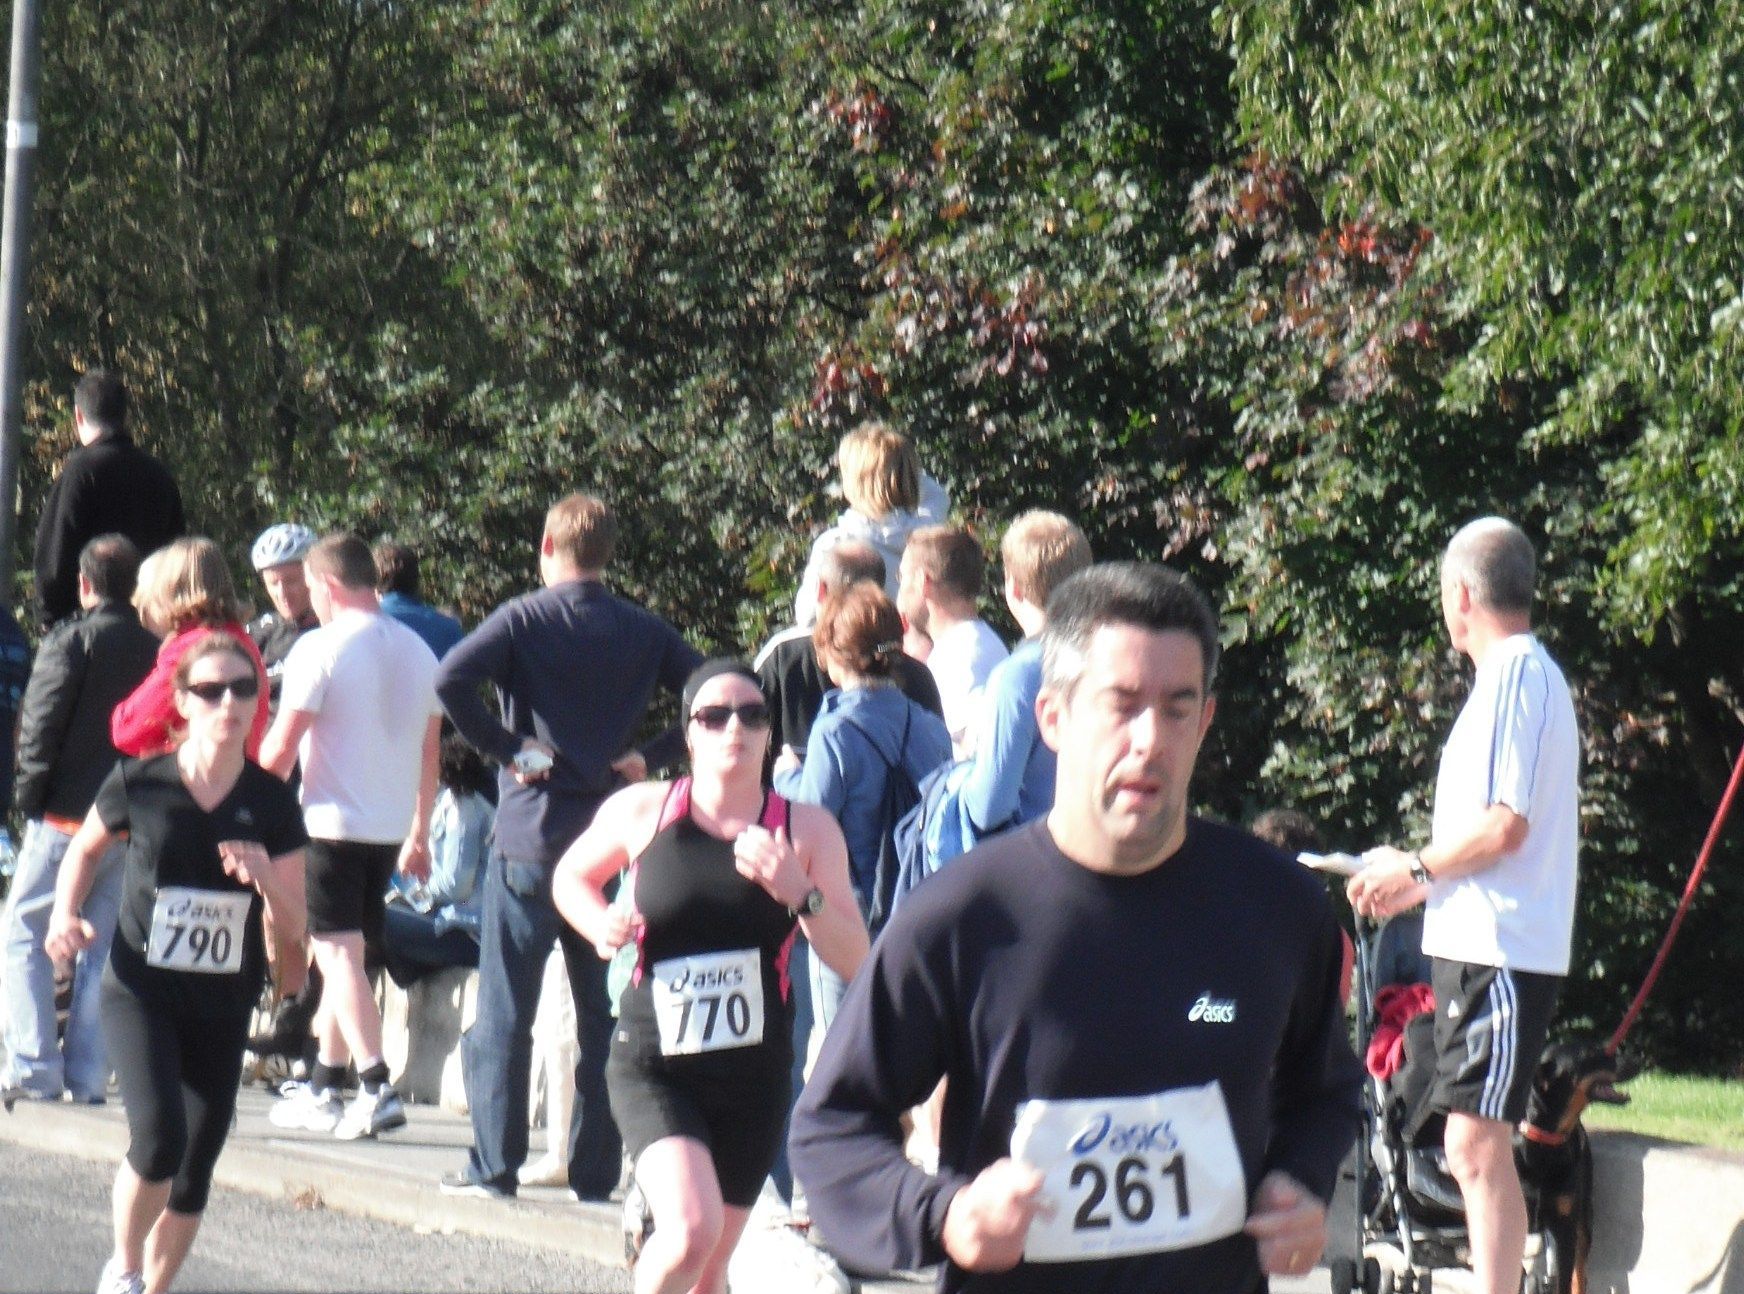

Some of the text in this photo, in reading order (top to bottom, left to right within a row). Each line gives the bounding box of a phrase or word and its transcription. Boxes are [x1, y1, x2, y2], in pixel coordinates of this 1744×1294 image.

[163, 923, 231, 964] 790
[672, 990, 751, 1044] 770
[1070, 1152, 1191, 1230] 261
